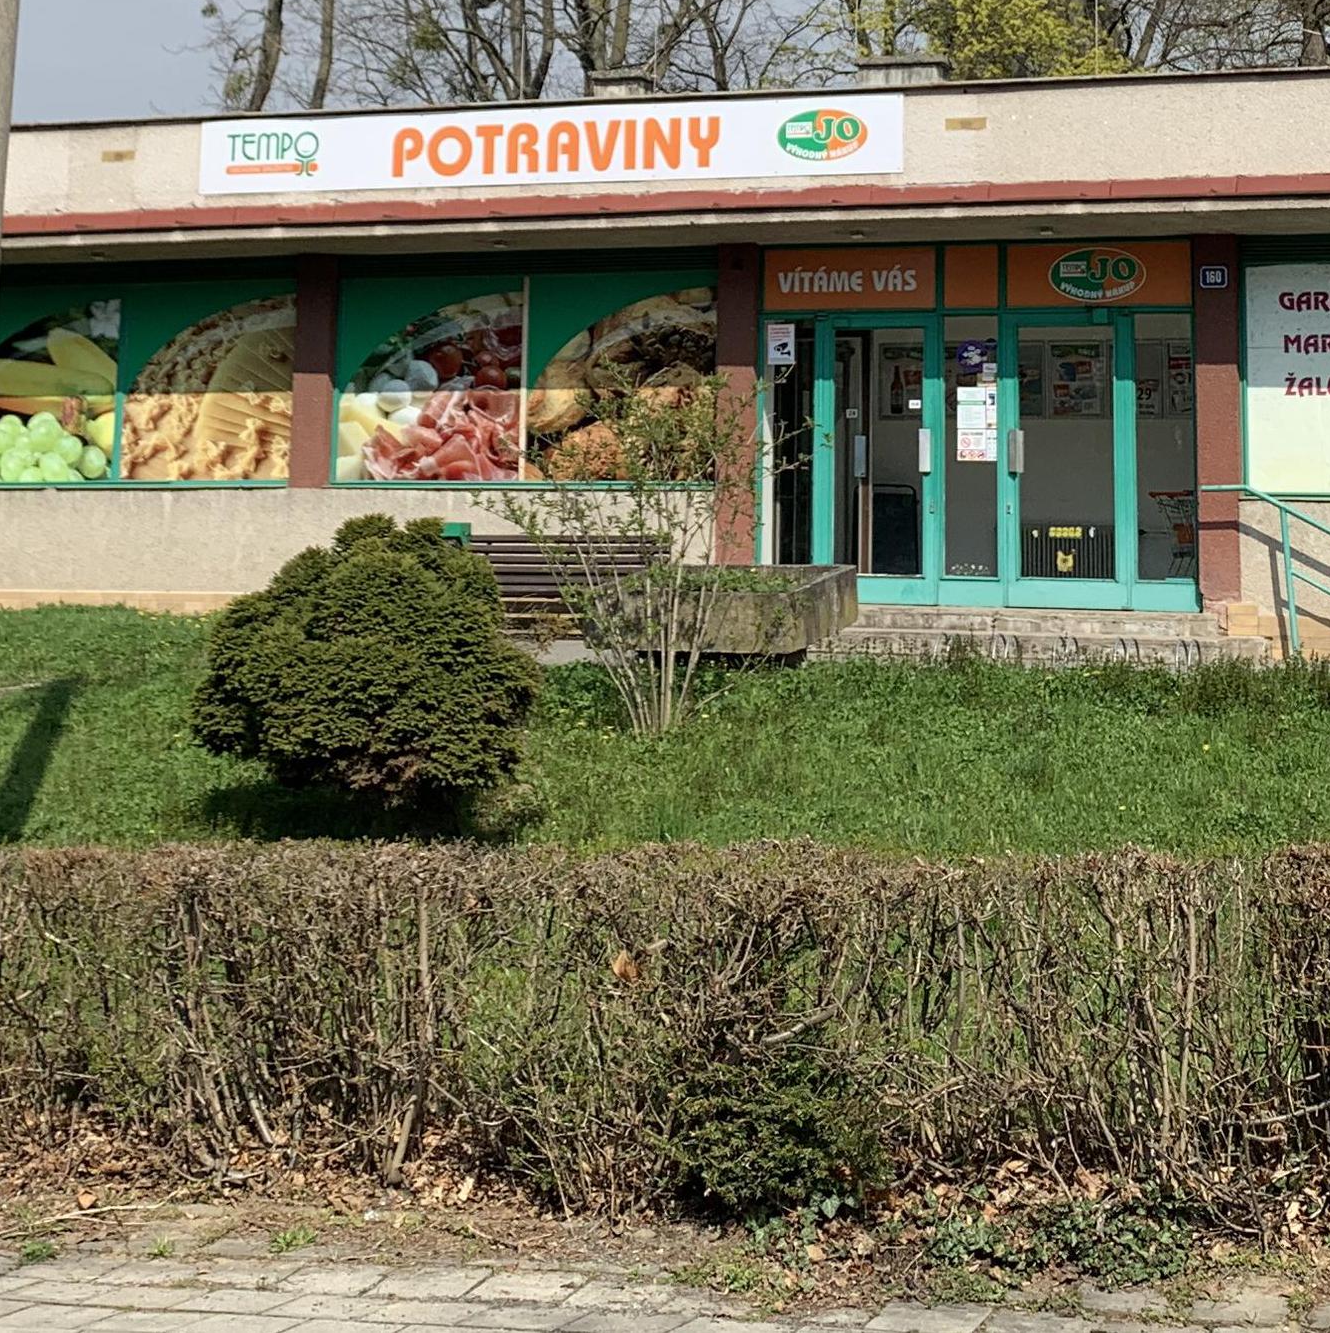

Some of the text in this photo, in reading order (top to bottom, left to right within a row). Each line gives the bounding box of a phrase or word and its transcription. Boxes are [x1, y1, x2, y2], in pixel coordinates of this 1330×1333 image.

[813, 116, 861, 143] JO
[227, 131, 319, 162] TEMPO
[392, 116, 720, 178] POTRAVINY
[778, 264, 918, 294] VÍTÁME VÁS
[1087, 255, 1139, 283] JO
[1205, 270, 1222, 284] 160
